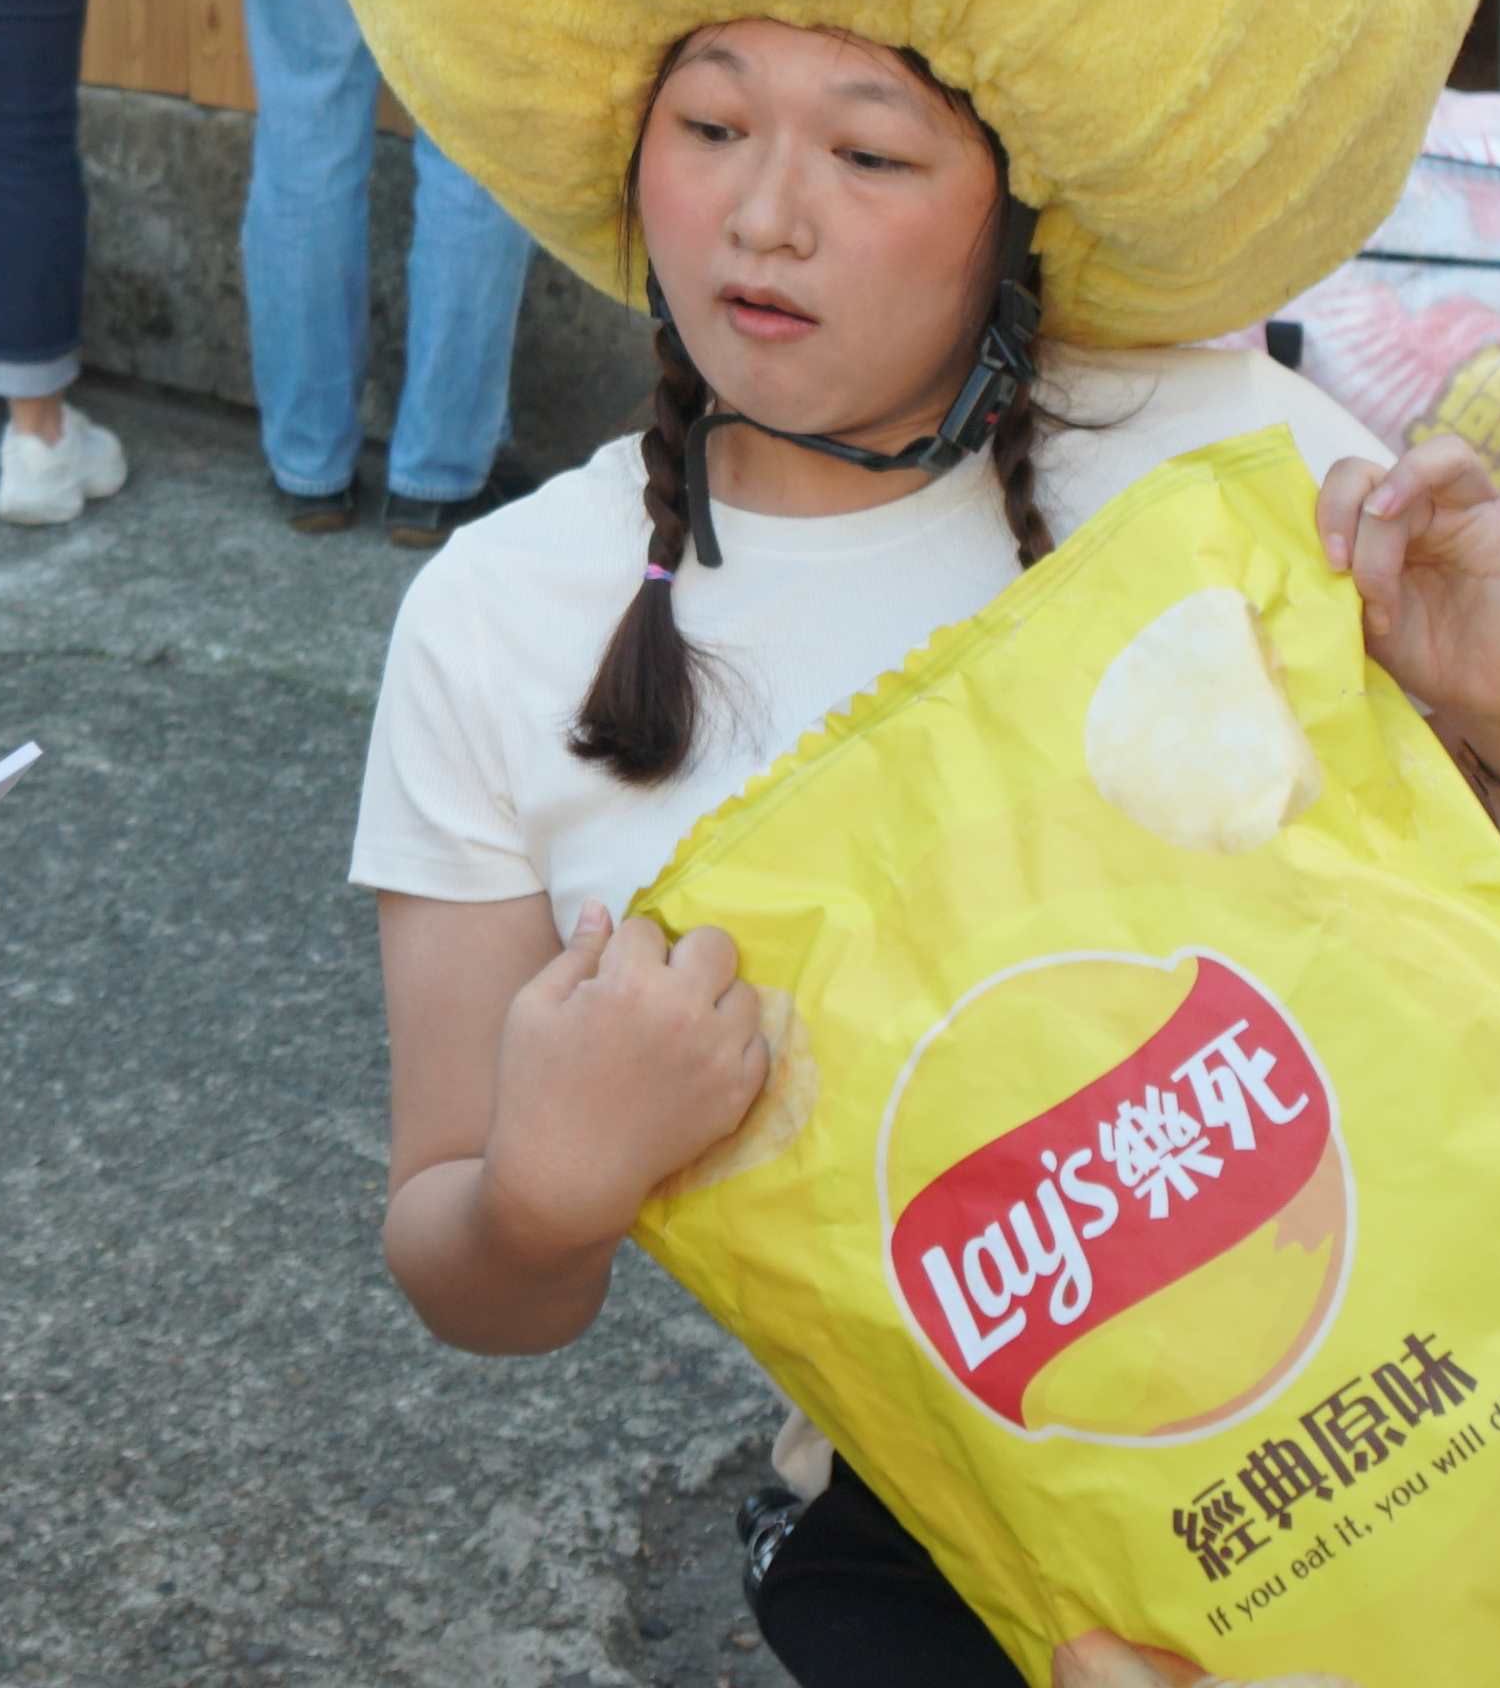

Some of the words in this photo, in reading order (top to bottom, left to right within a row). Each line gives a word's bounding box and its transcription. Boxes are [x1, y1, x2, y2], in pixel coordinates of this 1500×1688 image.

[921, 1147, 1119, 1373] Lay's
[1099, 1018, 1309, 1219] 樂死
[1172, 1331, 1478, 1583] 經典原味
[1207, 1607, 1233, 1637] If
[1235, 1575, 1287, 1622] you
[1291, 1537, 1336, 1580] eat
[1340, 1515, 1373, 1547] it,
[1375, 1472, 1430, 1521] you
[1432, 1424, 1486, 1475] will
